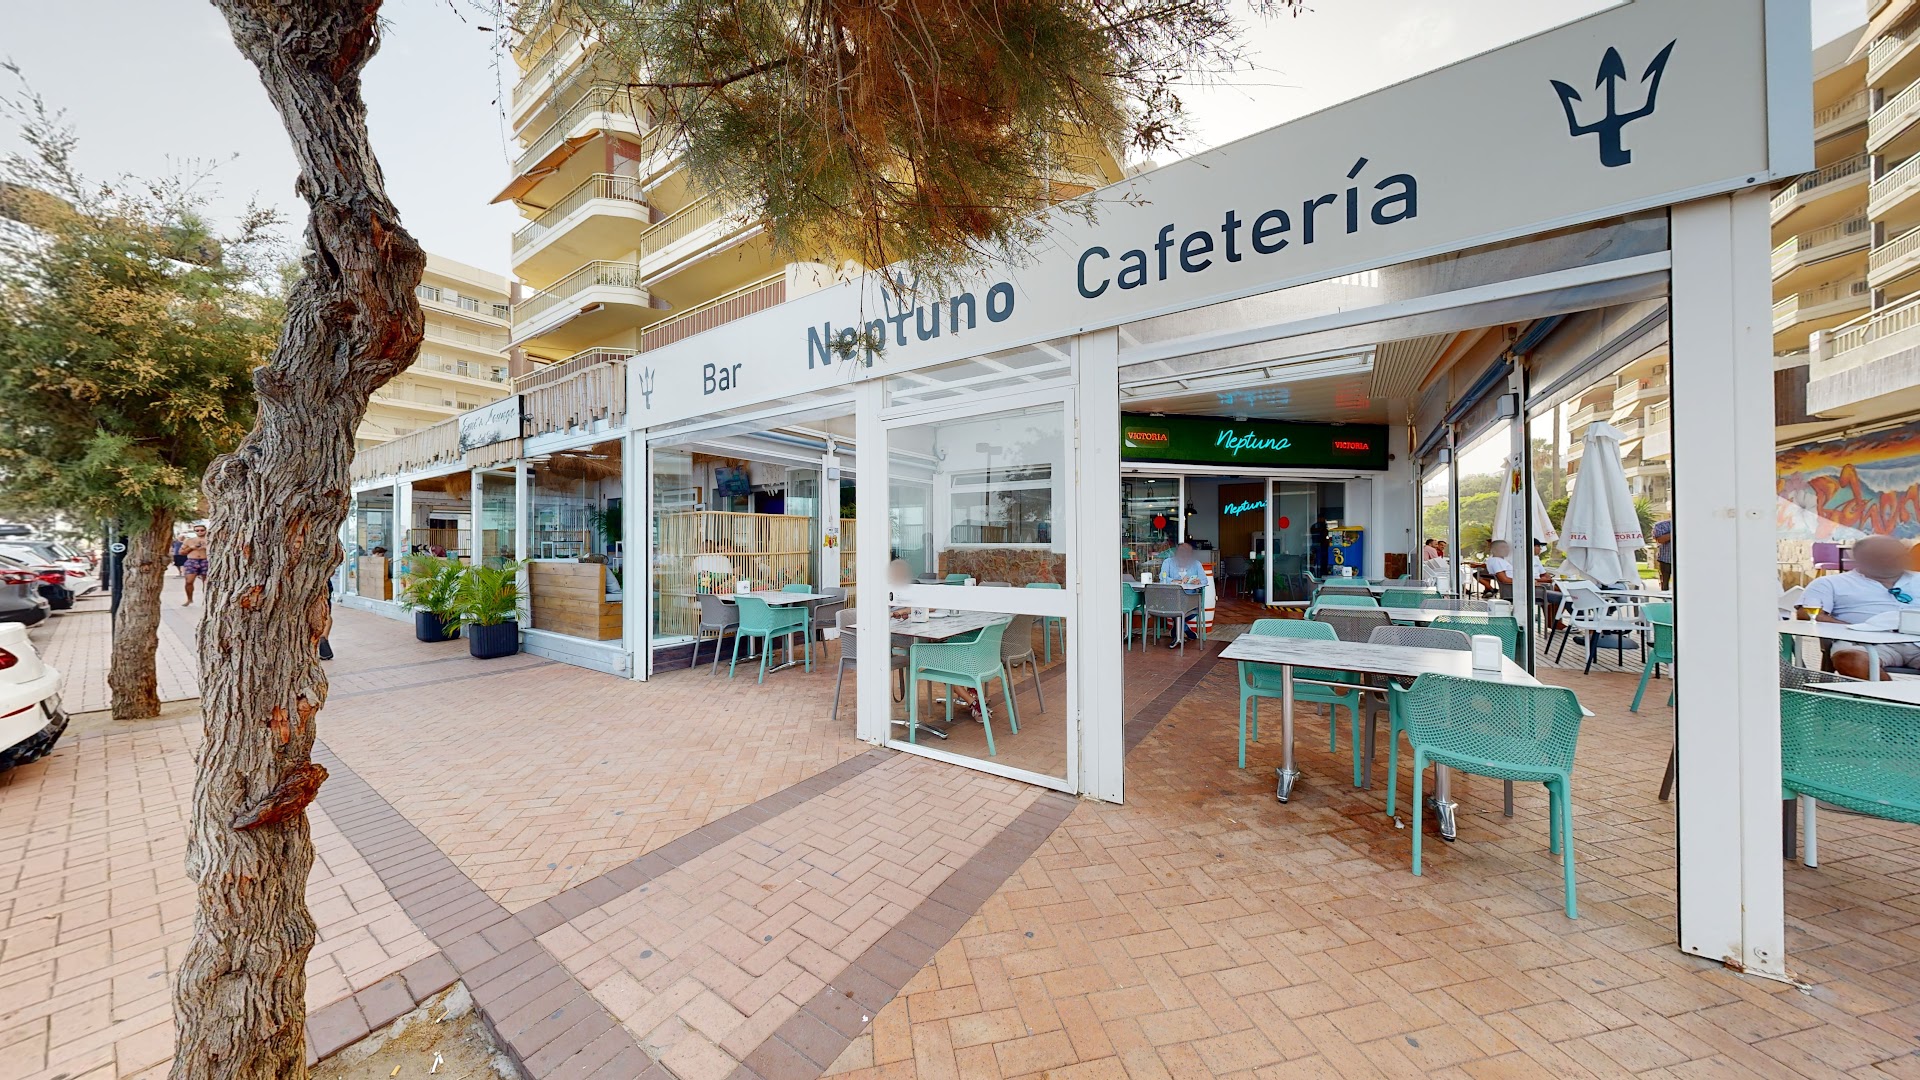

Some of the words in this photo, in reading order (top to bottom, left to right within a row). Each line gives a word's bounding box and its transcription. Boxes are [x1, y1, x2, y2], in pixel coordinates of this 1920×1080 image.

[702, 362, 742, 396] Bar
[807, 271, 1015, 370] Neptuno
[1077, 157, 1418, 299] Cafetería
[1127, 431, 1168, 441] VICTORIA
[1215, 429, 1291, 456] Neptuno
[1334, 441, 1369, 450] VICTORIA
